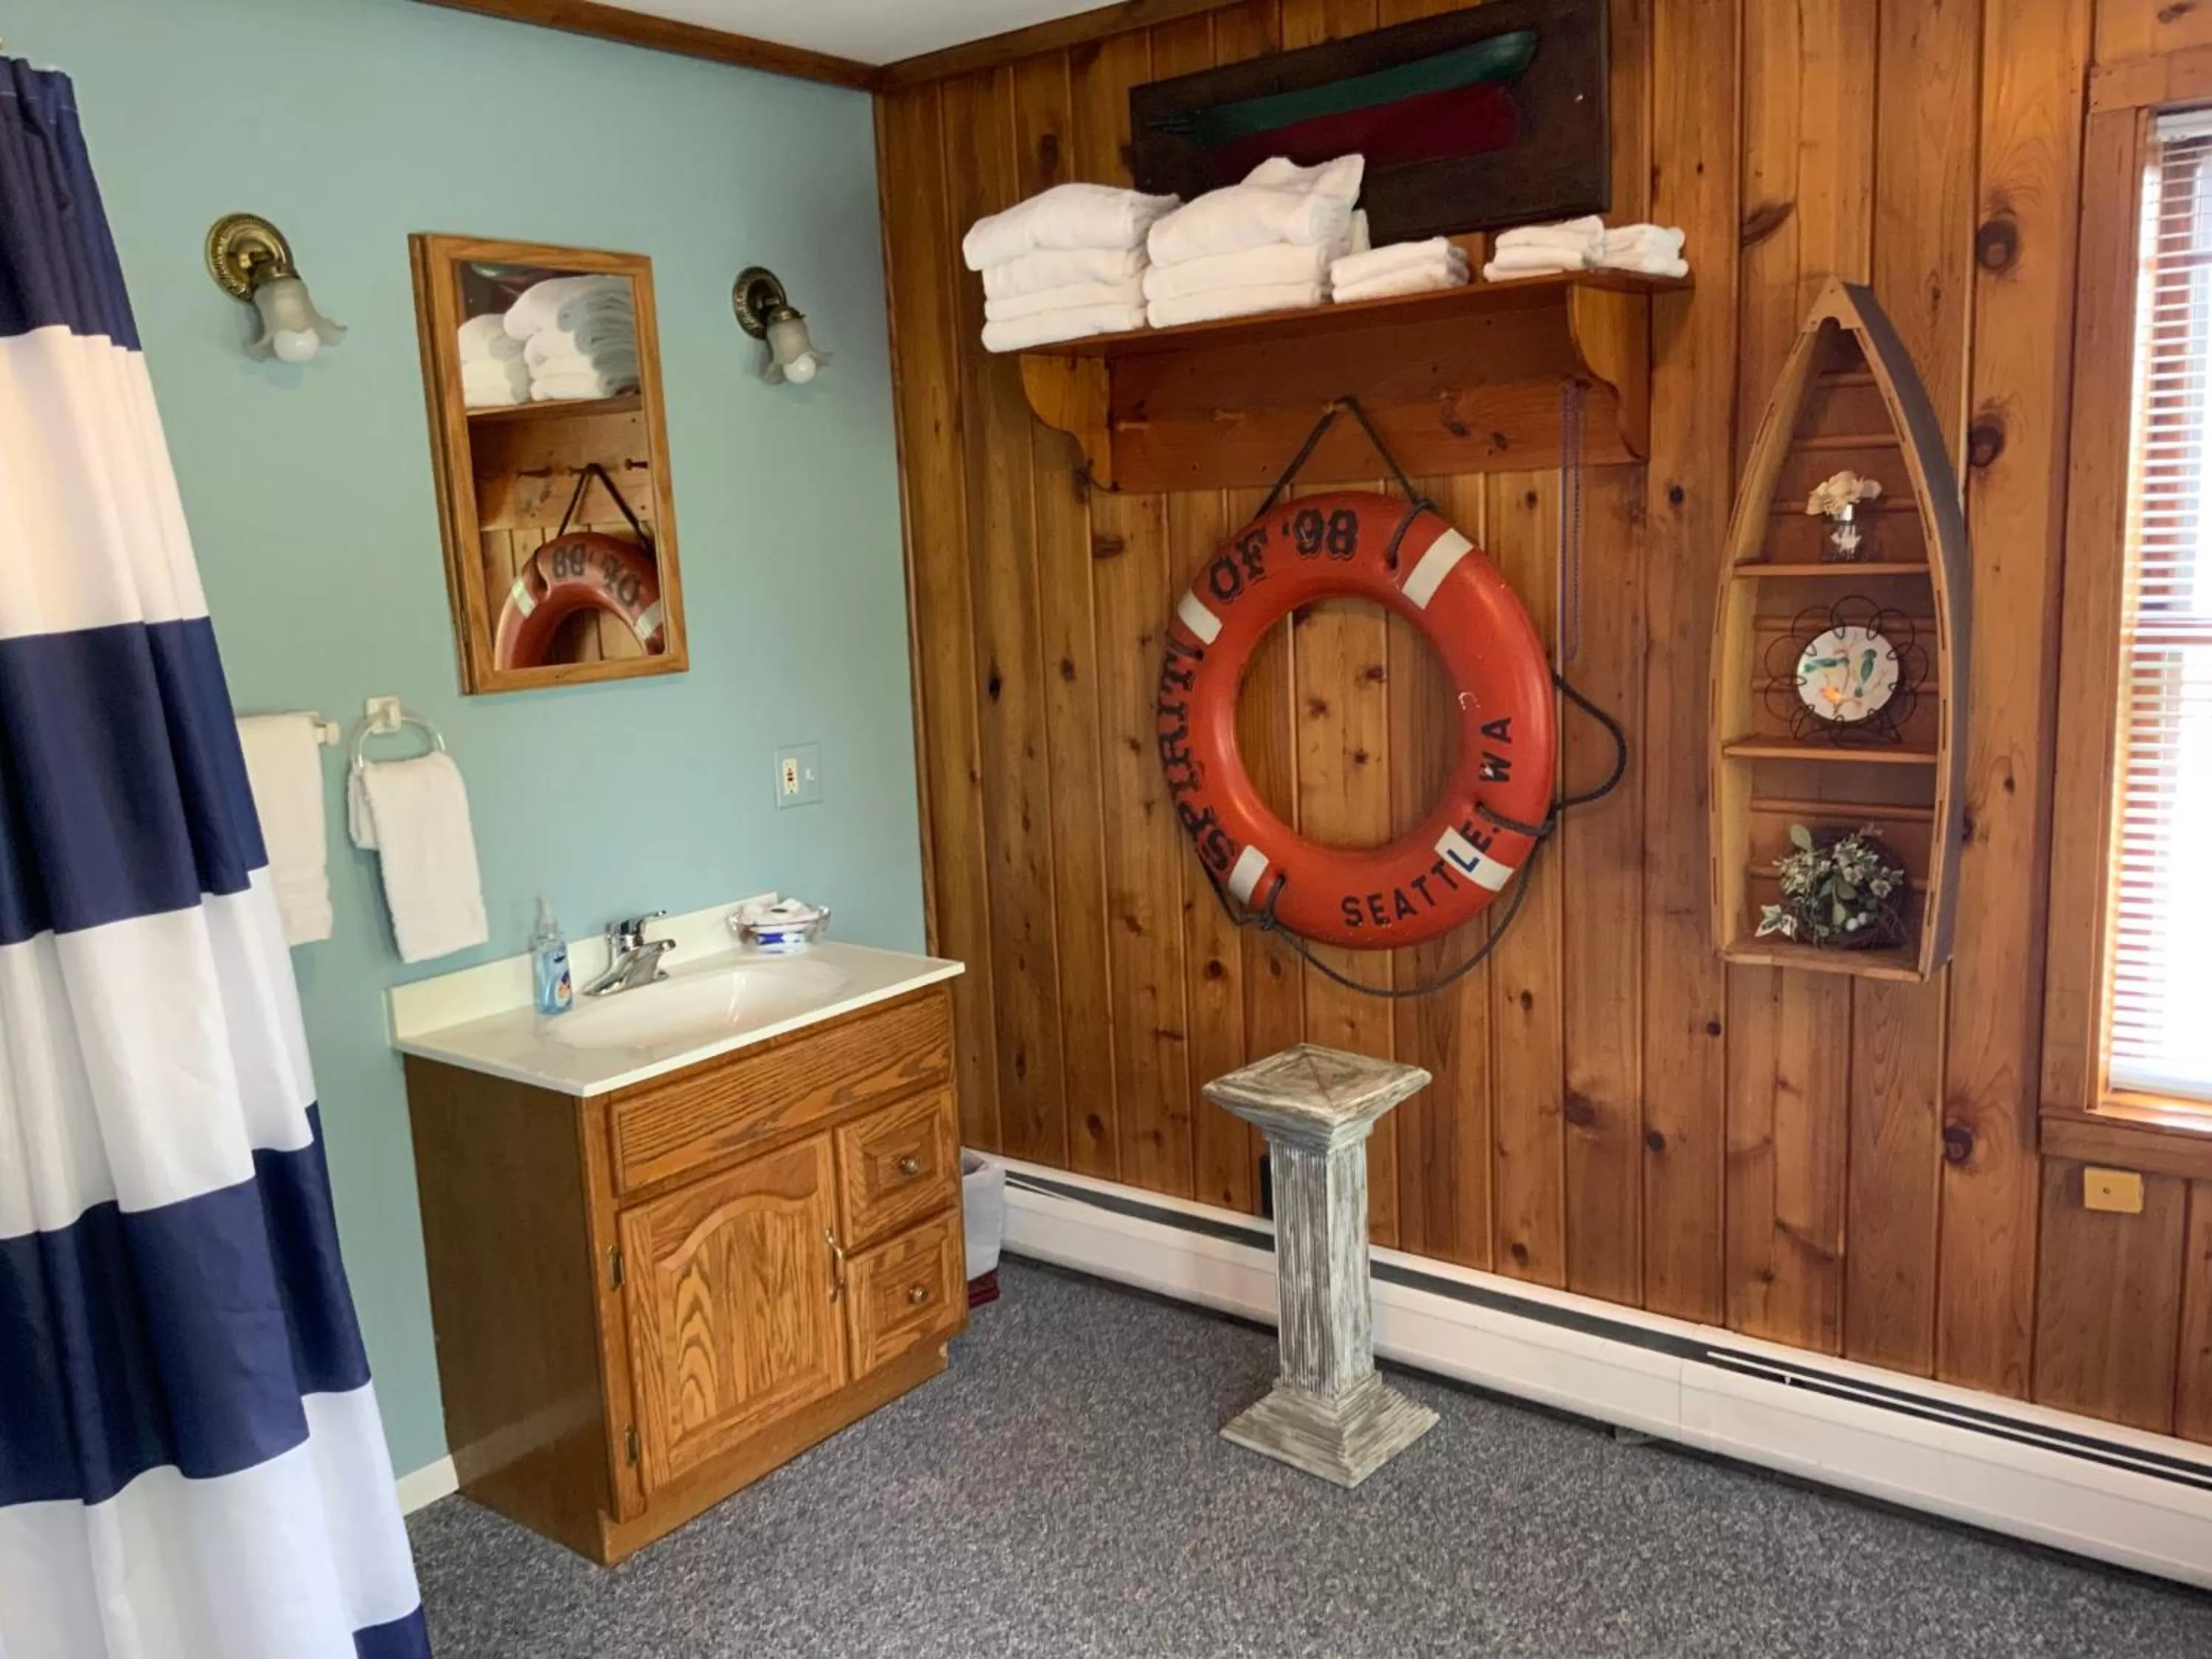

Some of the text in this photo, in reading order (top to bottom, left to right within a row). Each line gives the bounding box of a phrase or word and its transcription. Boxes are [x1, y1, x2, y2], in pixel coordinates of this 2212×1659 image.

[1158, 647, 1235, 872] SPIRIT
[1209, 525, 1268, 603] OF
[1479, 717, 1512, 782] WA
